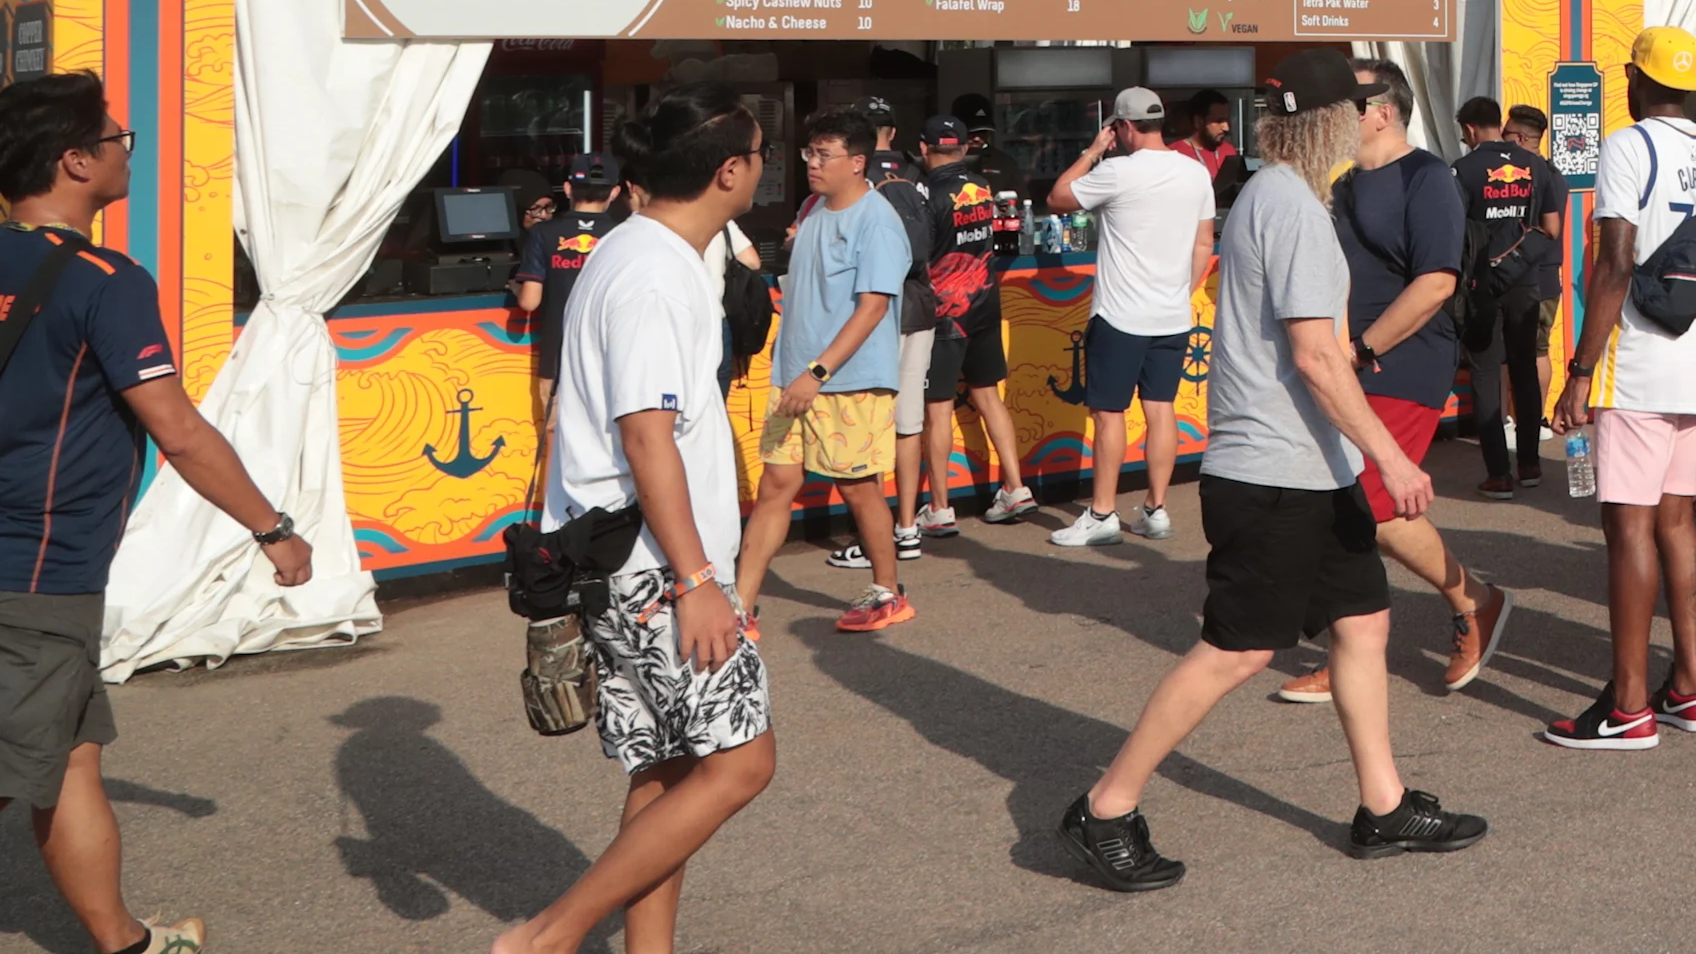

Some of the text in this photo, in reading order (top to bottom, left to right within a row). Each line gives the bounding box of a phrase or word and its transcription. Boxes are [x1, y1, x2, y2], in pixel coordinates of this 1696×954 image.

[1067, 0, 1080, 12] 18
[1433, 0, 1439, 10] 3
[726, 15, 827, 29] Nacho & Cheese
[857, 16, 872, 30] 10
[1301, 15, 1349, 27] Soft Drinks
[1433, 17, 1439, 28] 4
[1231, 24, 1258, 34] VEGAN
[1484, 184, 1532, 199] Red Bul
[953, 209, 977, 227] Red
[1486, 206, 1516, 219] Mobil
[957, 227, 987, 245] Mobil
[552, 255, 582, 268] Red
